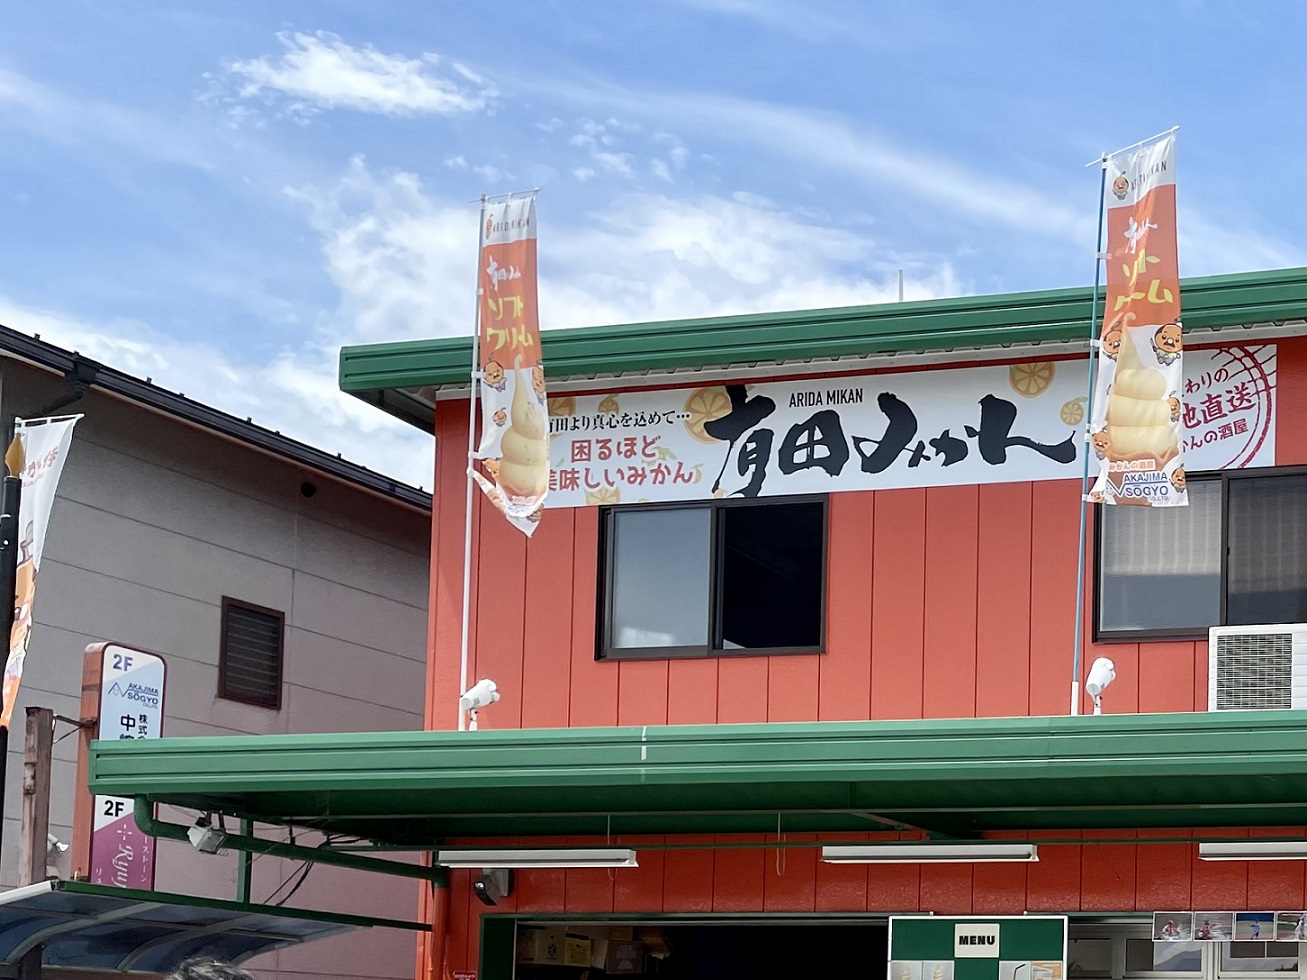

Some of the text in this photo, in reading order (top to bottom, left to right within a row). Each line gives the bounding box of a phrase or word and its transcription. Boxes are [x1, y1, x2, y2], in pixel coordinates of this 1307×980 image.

[1182, 367, 1229, 397] わりの
[789, 388, 863, 408] ARIDA MIKAN
[571, 435, 661, 463] 困るほど
[705, 384, 1076, 498] 有田みかん
[1124, 472, 1168, 482] AKAJIMA
[113, 653, 133, 671] 2F
[129, 683, 158, 694] AKAJIMA
[104, 800, 124, 817] 2F
[958, 935, 996, 946] MENU
